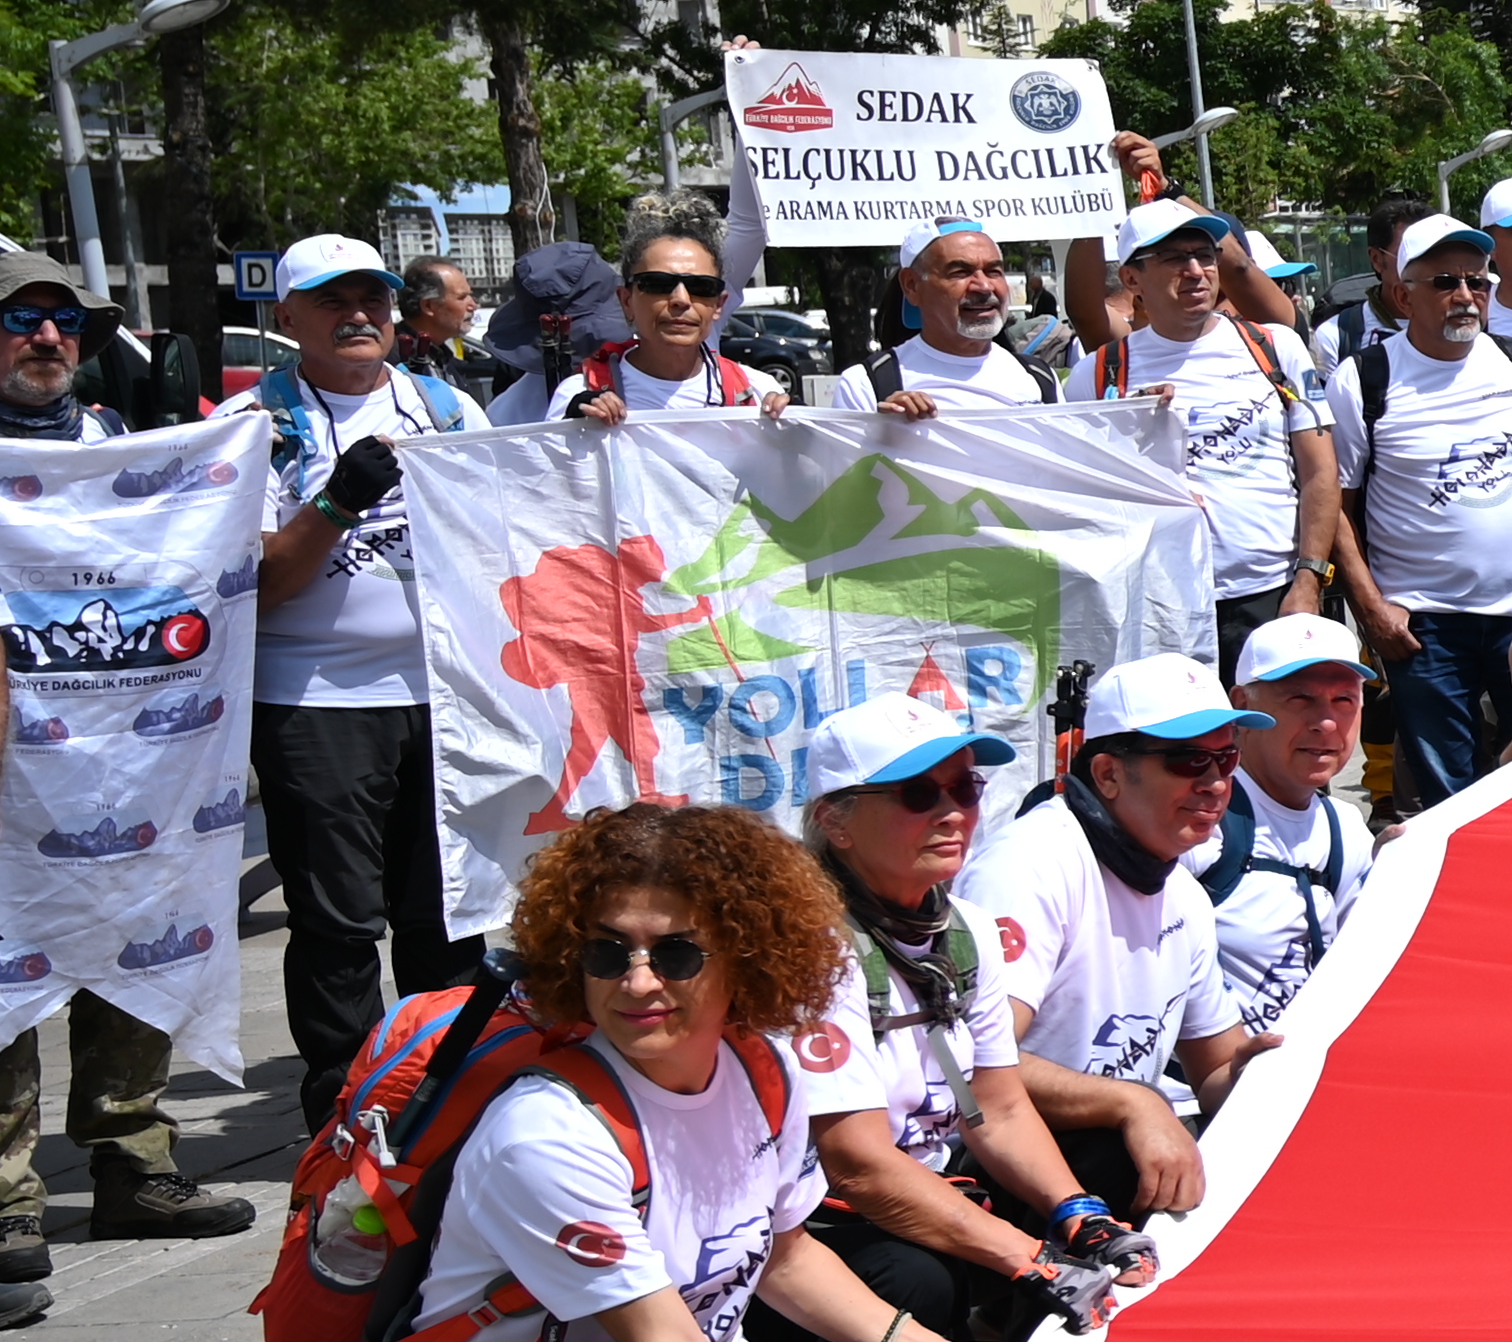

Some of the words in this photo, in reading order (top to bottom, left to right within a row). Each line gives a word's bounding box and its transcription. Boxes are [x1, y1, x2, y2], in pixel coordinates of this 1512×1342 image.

[856, 89, 977, 124] SEDAK
[746, 146, 917, 191] SELÇUKLU
[936, 141, 1109, 182] DAĞCILIK
[776, 200, 848, 220] ARAMA
[855, 199, 966, 220] KURTARMA
[974, 198, 1025, 218] SPOR
[1032, 188, 1114, 216] KULÜBÜ
[248, 263, 266, 288] D
[71, 571, 117, 587] 1966
[8, 677, 49, 693] ÜRKİYE
[52, 674, 116, 691] DAĞCILIK
[119, 667, 203, 689] FEDERASYONU
